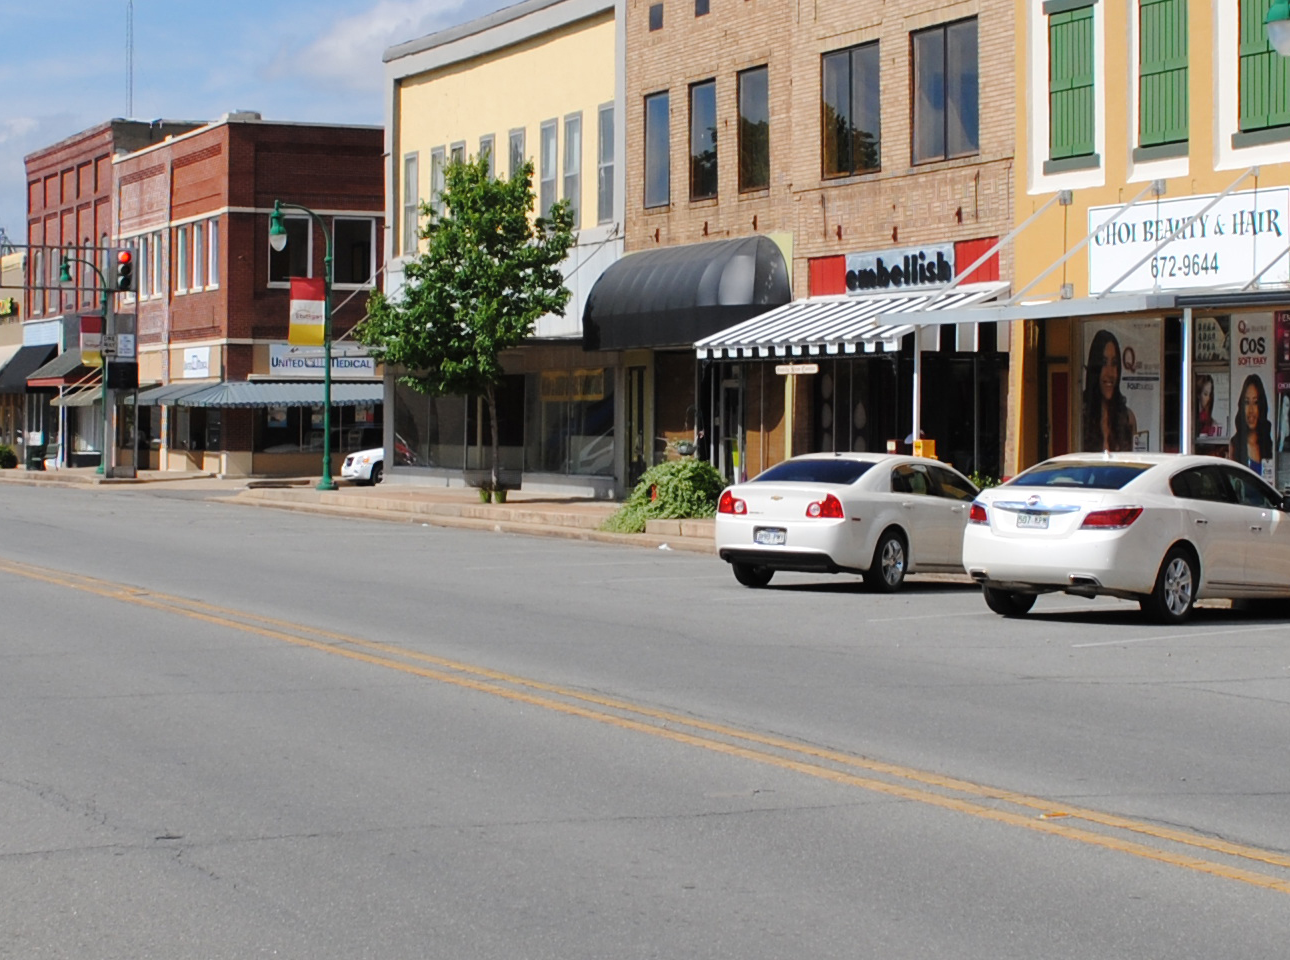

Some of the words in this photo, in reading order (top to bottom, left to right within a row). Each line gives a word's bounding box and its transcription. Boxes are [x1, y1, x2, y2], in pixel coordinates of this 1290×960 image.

[1095, 221, 1137, 246] CHOI
[1143, 214, 1209, 243] BEAUTY
[1214, 214, 1226, 236] &
[1232, 208, 1283, 238] HAIR
[846, 250, 952, 291] embellish
[1151, 252, 1218, 279] 672-9644
[1240, 337, 1265, 355] COS
[271, 357, 304, 368] UNITED
